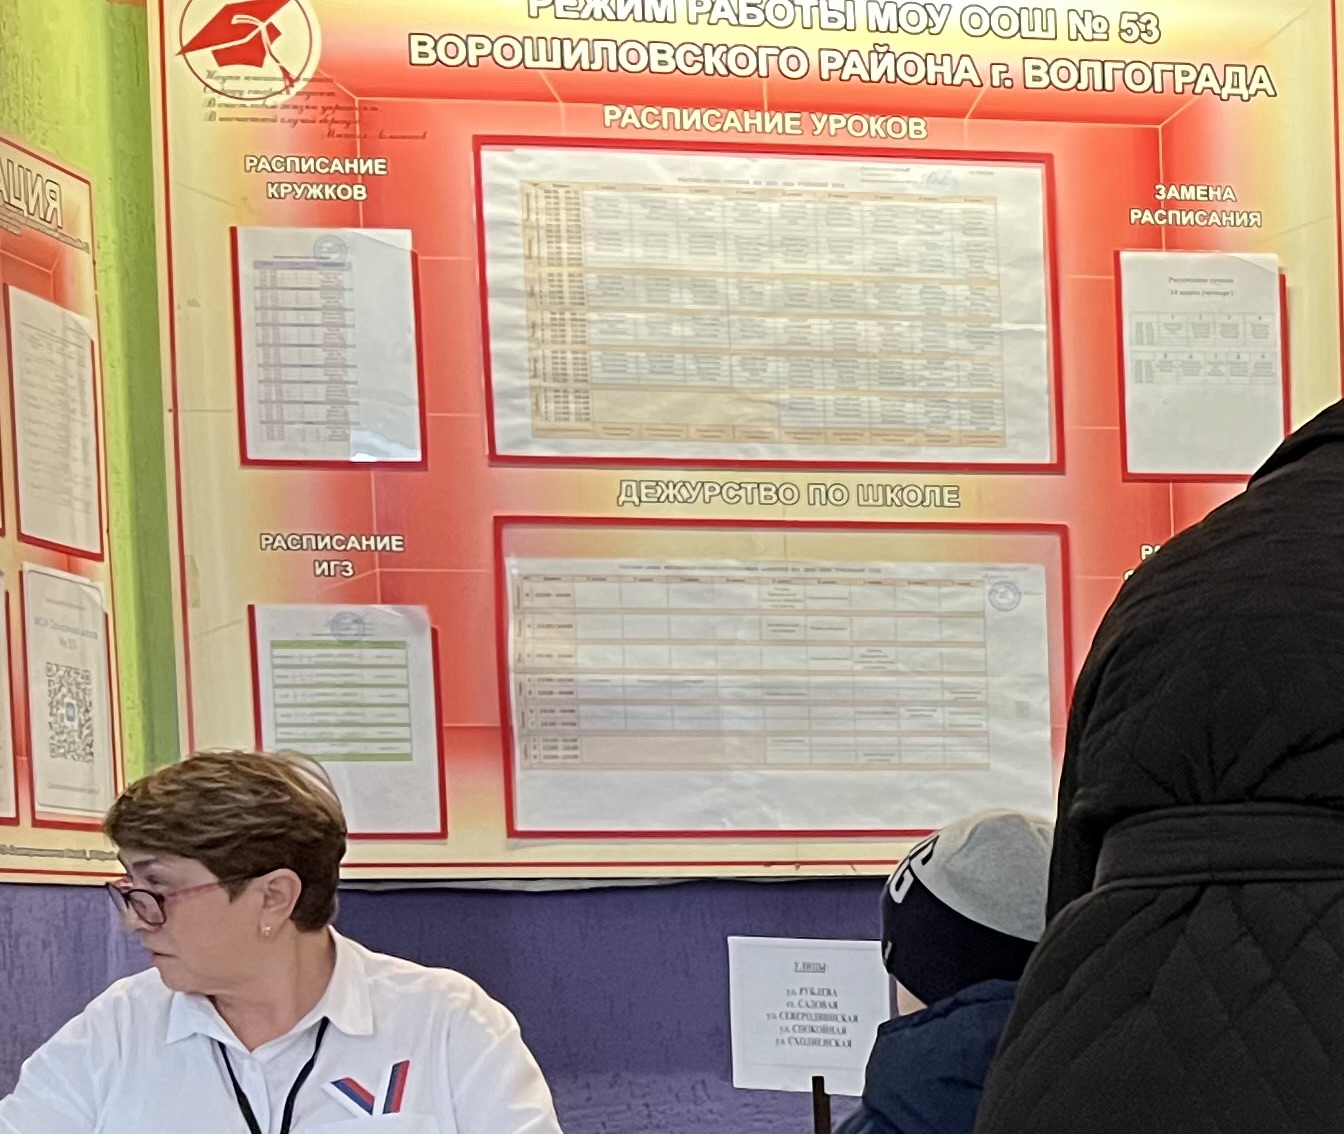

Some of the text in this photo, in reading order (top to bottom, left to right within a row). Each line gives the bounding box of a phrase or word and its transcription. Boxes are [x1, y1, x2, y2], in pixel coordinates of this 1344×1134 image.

[528, 0, 1161, 44] РЕЖИМ РАБОТЫ МОУ ООШ № 53
[408, 32, 1277, 102] ВОРОШИЛОВСКОГО РАЙОНА г. ВОЛГОГРАДА
[603, 103, 928, 140] РАСПИСАНИЕ УРОКОВ
[244, 155, 388, 176] РАСПИСАНИЕ
[266, 182, 367, 201] КРУЖКОВ
[1154, 184, 1238, 202] ЗАМЕНА
[1129, 207, 1262, 228] РАСПИСАНИЯ
[617, 480, 961, 508] ДЕЖУРСТВО ПО ШКОЛЕ
[260, 533, 404, 551] РАСПИСАНИЕ
[314, 559, 354, 577] ИГЗ
